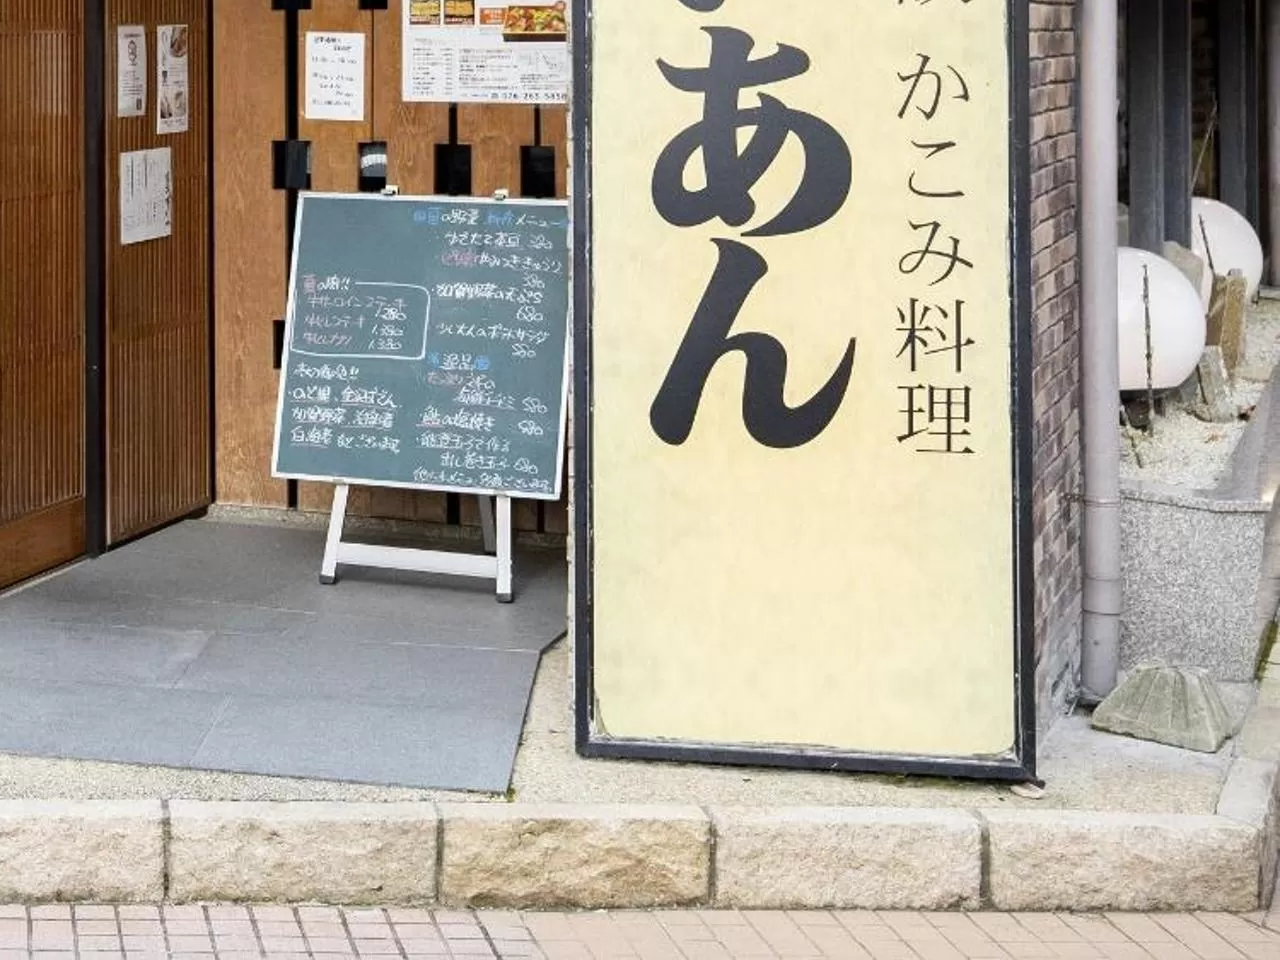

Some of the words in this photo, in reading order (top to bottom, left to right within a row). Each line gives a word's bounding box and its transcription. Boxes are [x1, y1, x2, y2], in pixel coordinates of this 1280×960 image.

[896, 53, 976, 455] かこみ料理
